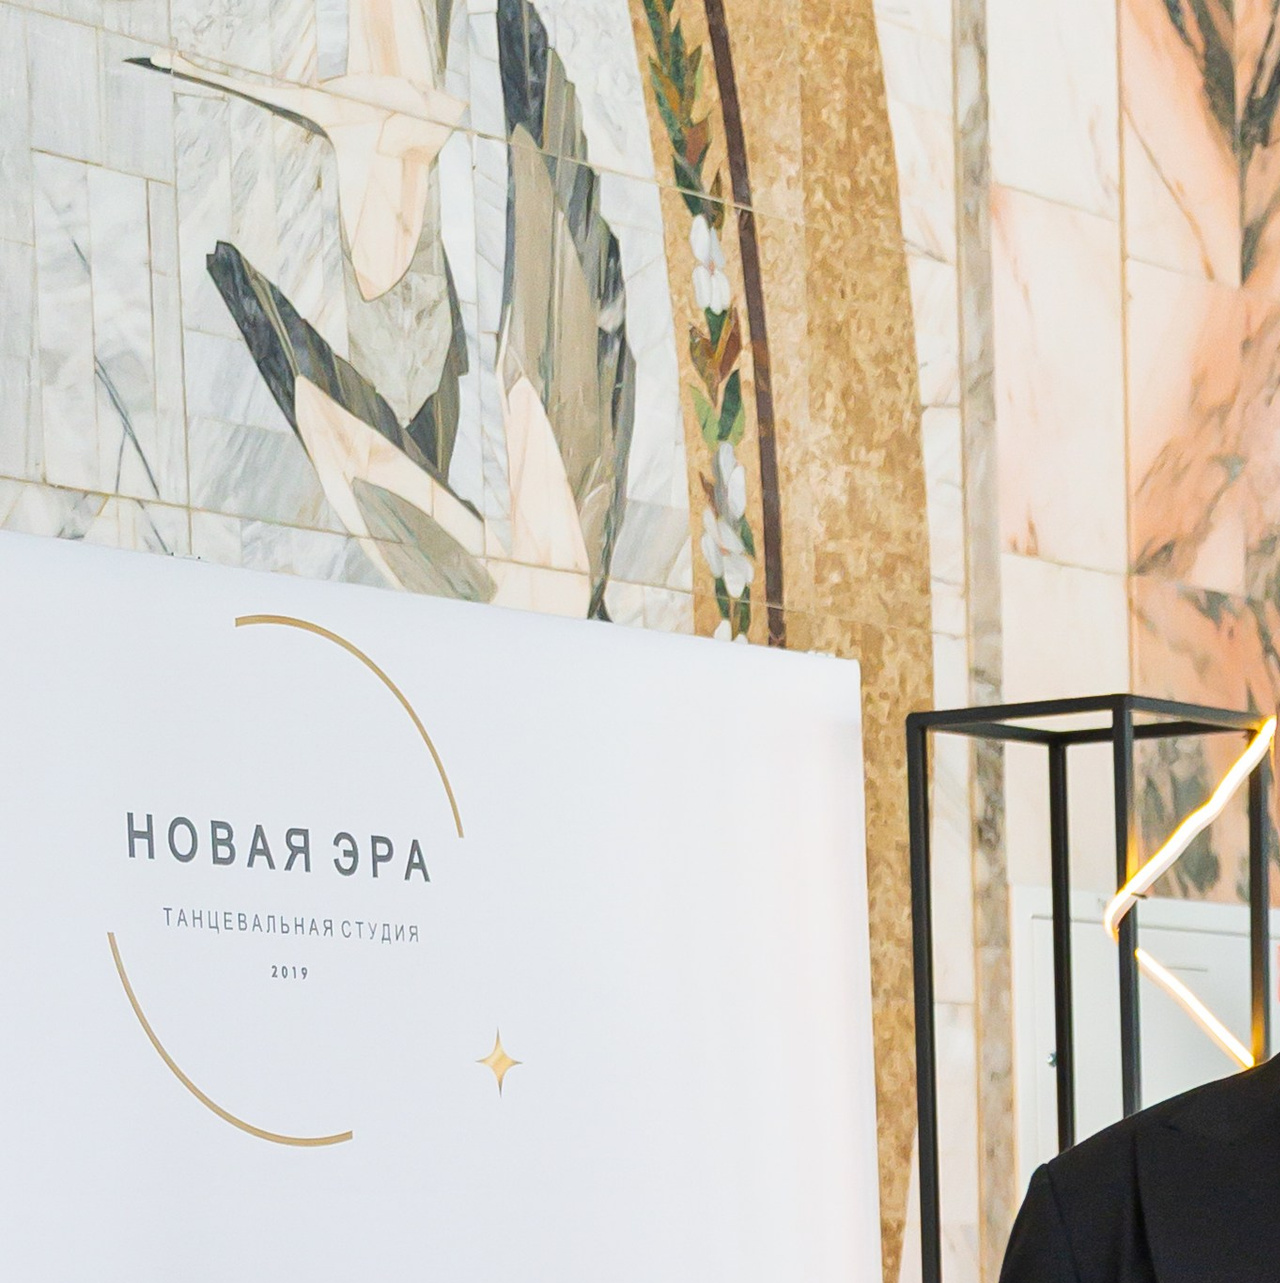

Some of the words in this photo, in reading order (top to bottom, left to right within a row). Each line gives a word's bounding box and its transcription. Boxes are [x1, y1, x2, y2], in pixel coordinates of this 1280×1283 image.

[126, 811, 311, 873] НОВАЯ
[332, 831, 431, 883] ЭРА
[162, 907, 334, 937] ТАНЦЕВАЛЬНАЯ
[340, 920, 420, 945] СТУДИЯ
[270, 964, 309, 980] 2019
